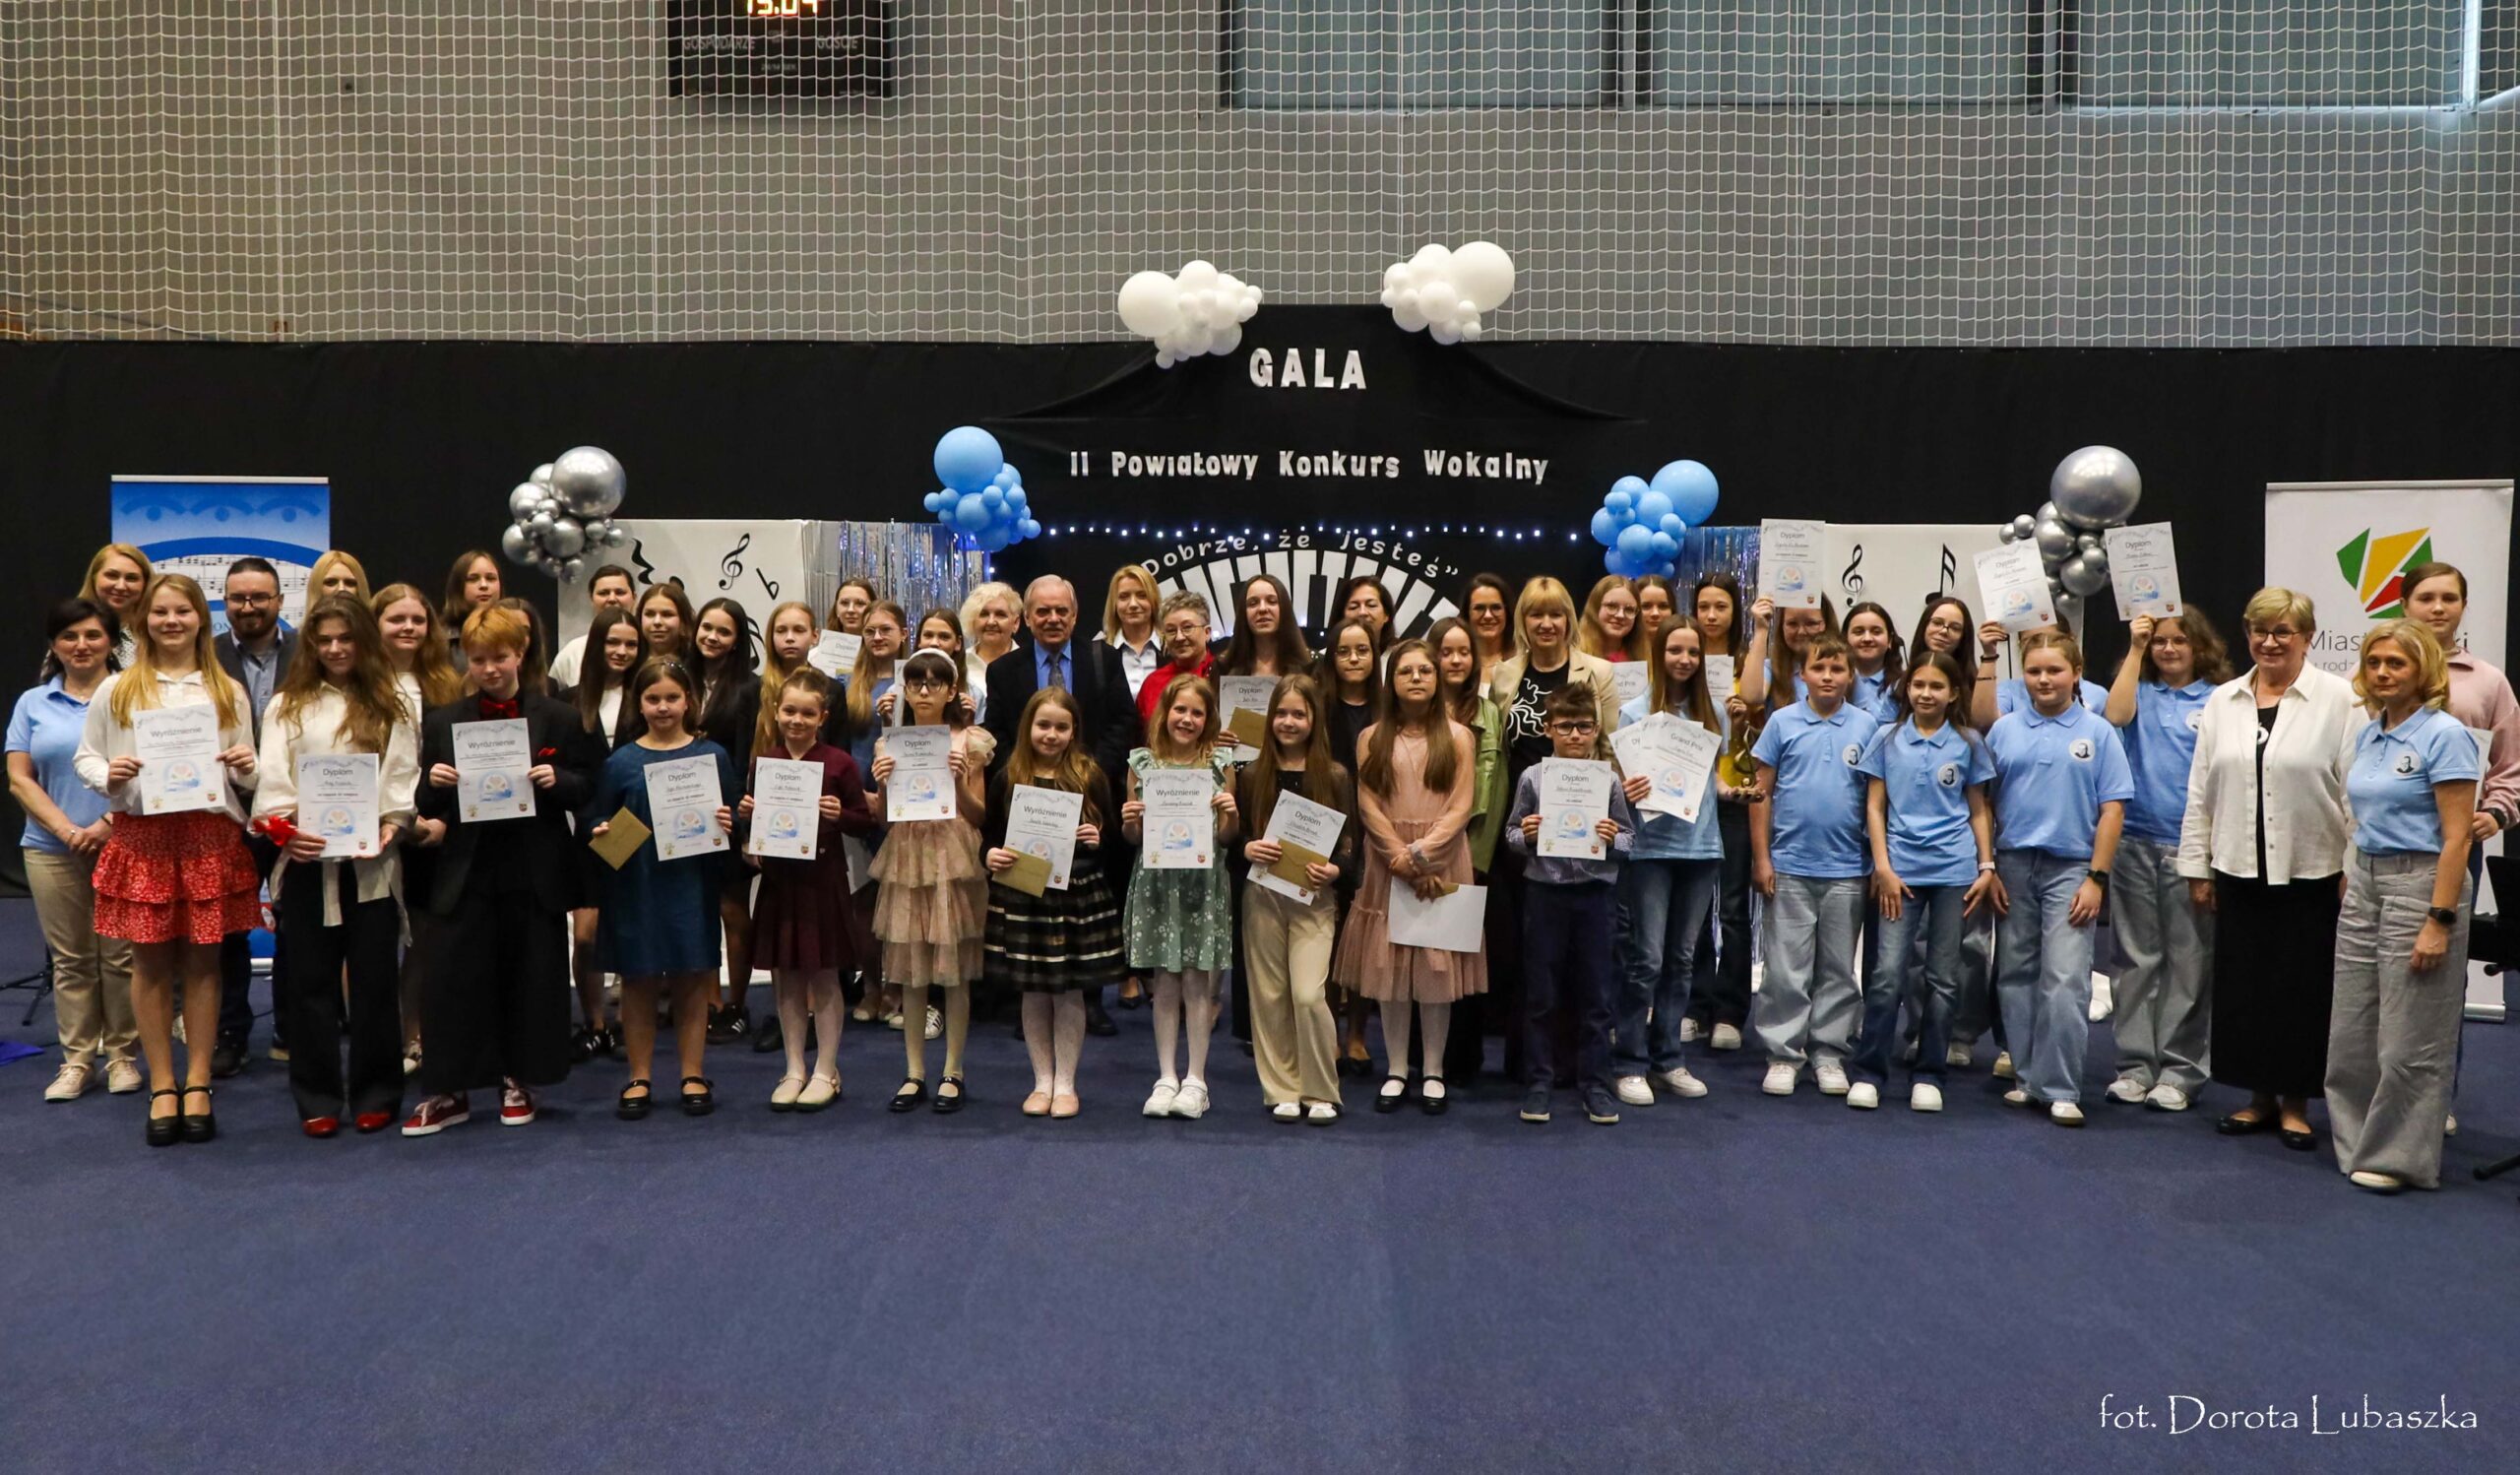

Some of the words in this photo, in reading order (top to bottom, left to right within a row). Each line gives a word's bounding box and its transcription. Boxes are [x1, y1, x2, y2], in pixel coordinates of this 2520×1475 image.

[1249, 348, 1367, 390] GALA
[1111, 450, 1259, 481] Powiatowy
[1279, 450, 1401, 480] Konkurs
[1423, 449, 1549, 485] Wokalny
[2125, 540, 2152, 549] Dyplom
[1140, 536, 1260, 577] Dobrze,
[1278, 529, 1310, 548] że
[2310, 629, 2367, 652] Mias
[1238, 686, 1264, 695] Dyplom
[905, 739, 932, 748] Dyplom
[1670, 733, 1690, 745] Grand
[1690, 738, 1705, 751] Prix
[323, 767, 353, 777] Dyplom
[667, 771, 697, 782] Dyplom
[775, 772, 802, 782] Dyplom
[1561, 773, 1590, 783] Dyplom
[1294, 810, 1322, 827] Dyplom
